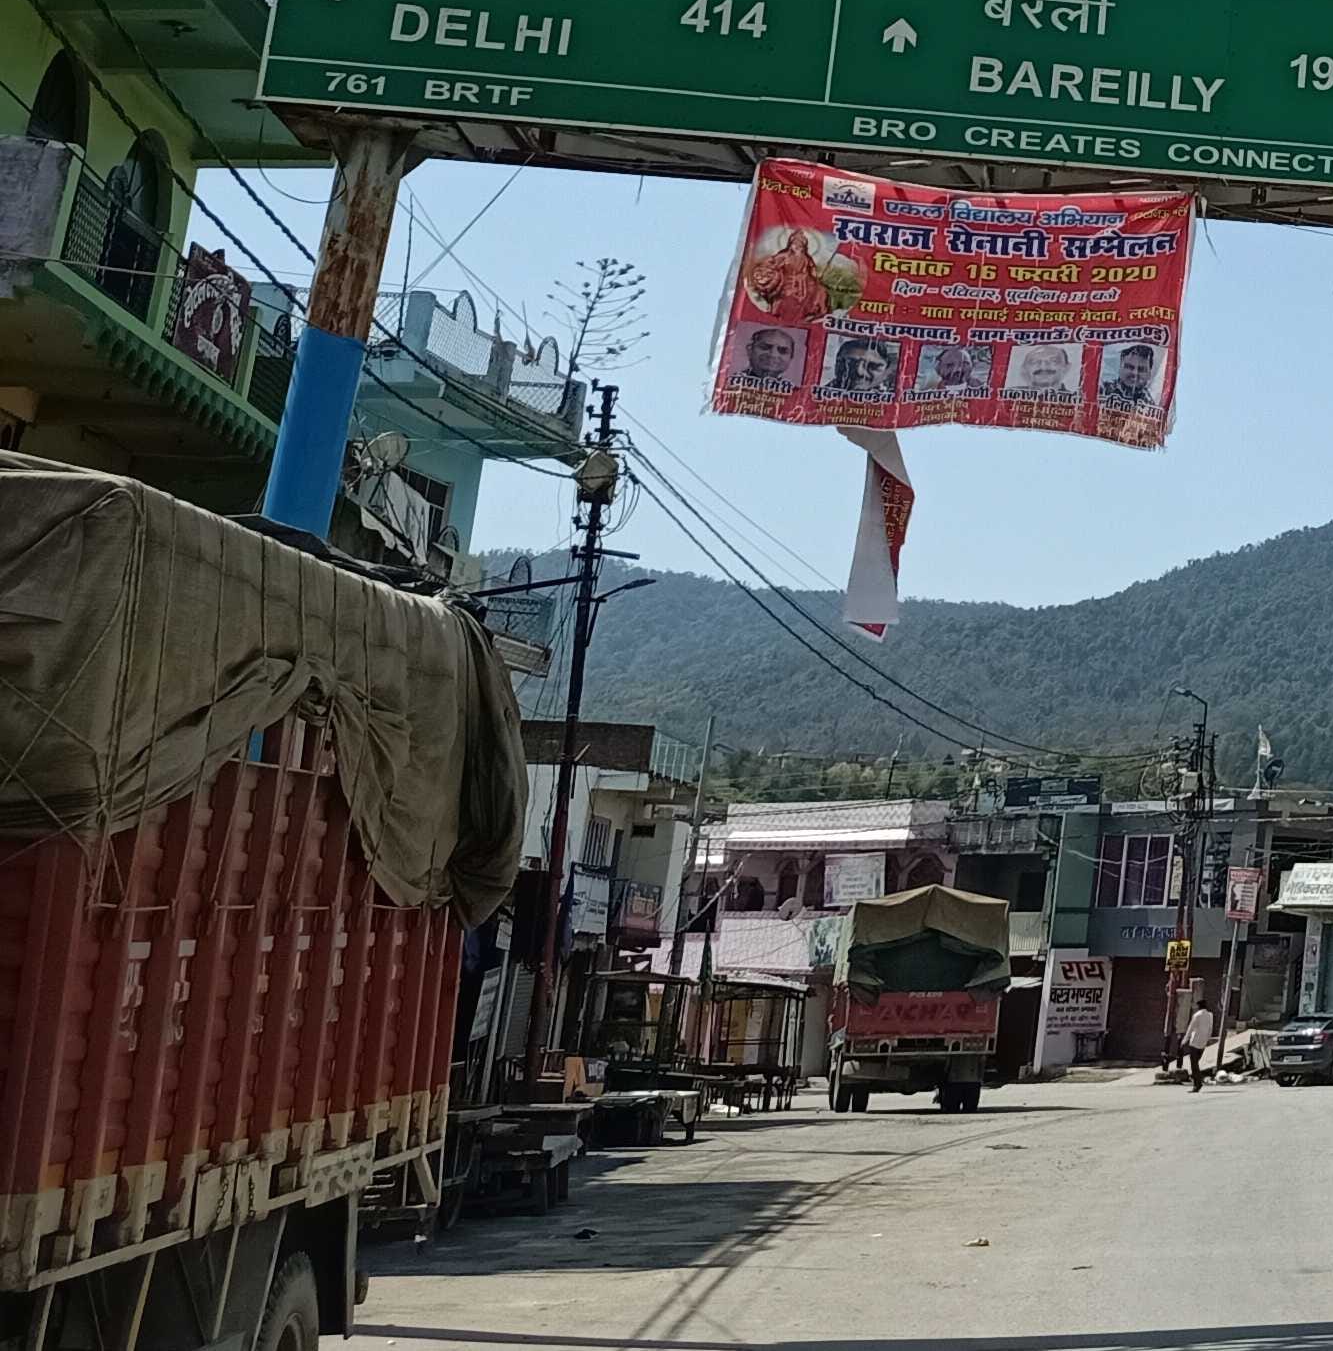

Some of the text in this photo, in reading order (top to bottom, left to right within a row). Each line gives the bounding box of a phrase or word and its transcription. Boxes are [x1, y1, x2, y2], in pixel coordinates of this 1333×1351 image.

[389, 2, 573, 56] DELHI
[327, 73, 531, 107] 761 BRTF
[968, 55, 1226, 113] BAREILLY
[852, 116, 937, 142] BRO
[964, 125, 1141, 159] CREATES
[884, 200, 946, 220] एकल
[948, 200, 1036, 226] विद्यालय
[1038, 209, 1128, 229] अभियान
[873, 251, 1157, 284] दिनांक 16 फरवरी 2020
[1059, 960, 1106, 982] राय
